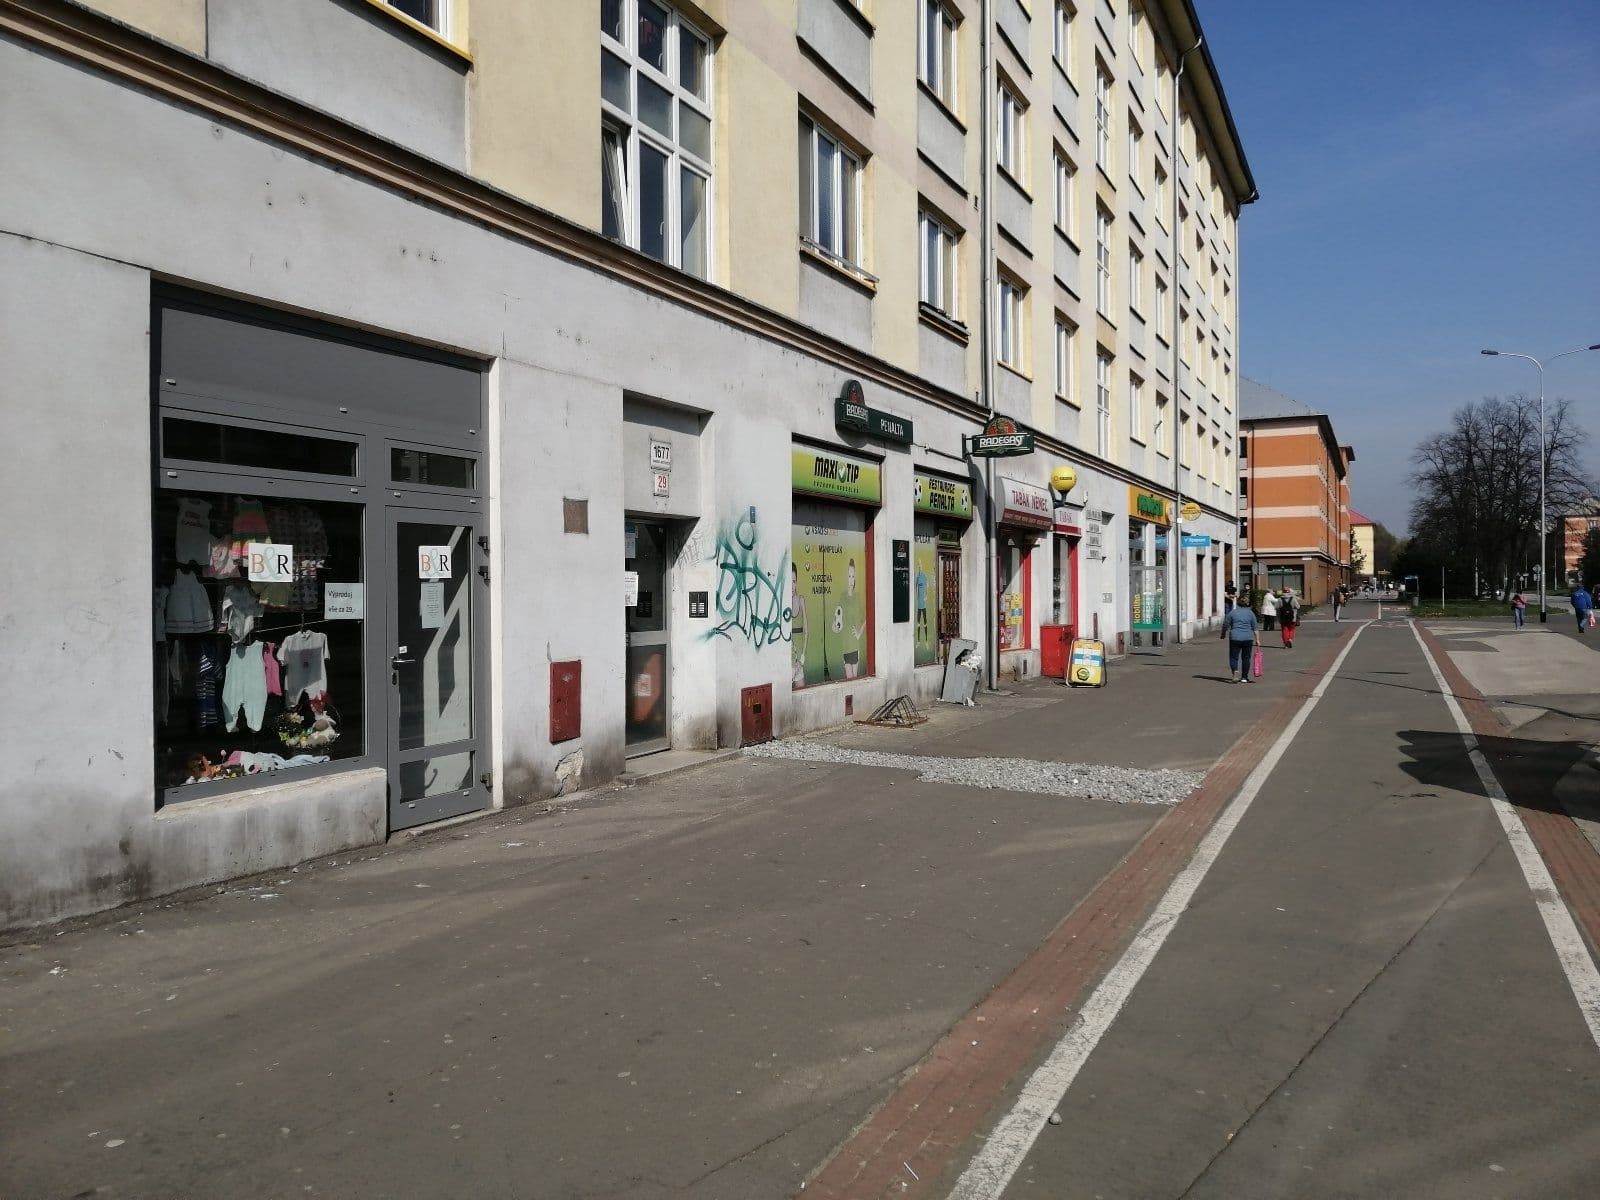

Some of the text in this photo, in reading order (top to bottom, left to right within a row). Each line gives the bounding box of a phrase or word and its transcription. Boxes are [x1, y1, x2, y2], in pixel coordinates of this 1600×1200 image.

[880, 418, 904, 438] PENALTA
[979, 435, 1023, 448] RADEGAST
[653, 445, 670, 460] 1677
[814, 456, 859, 483] MAXI TIP
[657, 475, 667, 489] 29
